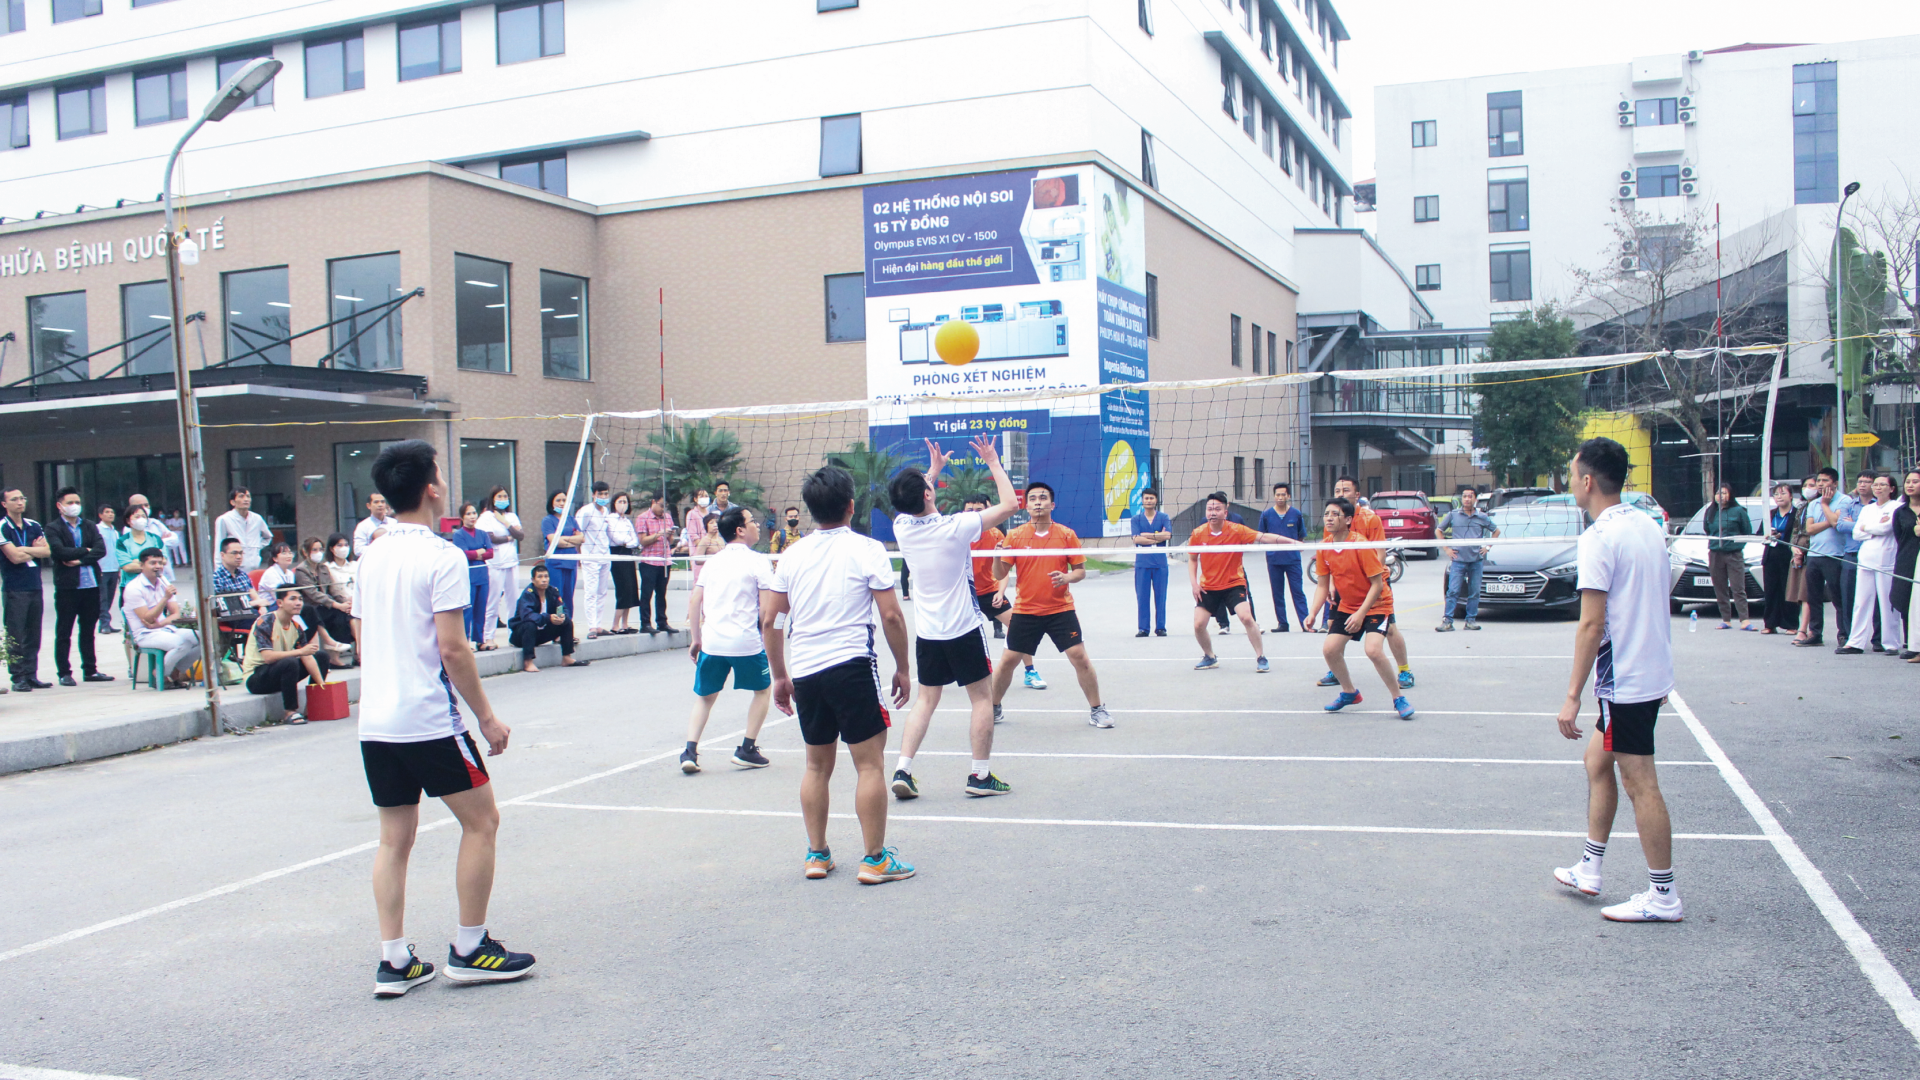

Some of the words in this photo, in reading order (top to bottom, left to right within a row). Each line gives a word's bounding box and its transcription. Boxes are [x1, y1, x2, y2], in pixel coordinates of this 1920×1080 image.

[873, 202, 890, 215] 02
[893, 197, 911, 214] HỆ
[913, 193, 960, 211] THỐNG
[963, 190, 987, 207] NỘI
[990, 189, 1014, 203] SOI
[873, 221, 889, 234] 15
[910, 213, 949, 230] ĐỒNG
[0, 246, 47, 277] HỮA
[56, 239, 114, 273] BỆNH
[123, 224, 188, 262] QUỐ
[196, 216, 225, 250] TẾ
[874, 239, 915, 252] Olympus
[917, 236, 938, 247] EVIS
[939, 234, 950, 244] X1
[952, 233, 965, 243] CV
[974, 230, 997, 241] 1500
[882, 263, 903, 275] Hiện
[905, 262, 919, 273] đại
[921, 260, 944, 271] hàng
[966, 255, 983, 267] thế
[984, 254, 1003, 267] giới
[913, 370, 960, 386] PHÒNG
[963, 369, 988, 383] XÉT
[992, 366, 1046, 382] NGHIỆM
[933, 421, 948, 433] Trị
[950, 420, 967, 432] giá
[970, 420, 983, 429] 23
[999, 417, 1027, 429] đồng
